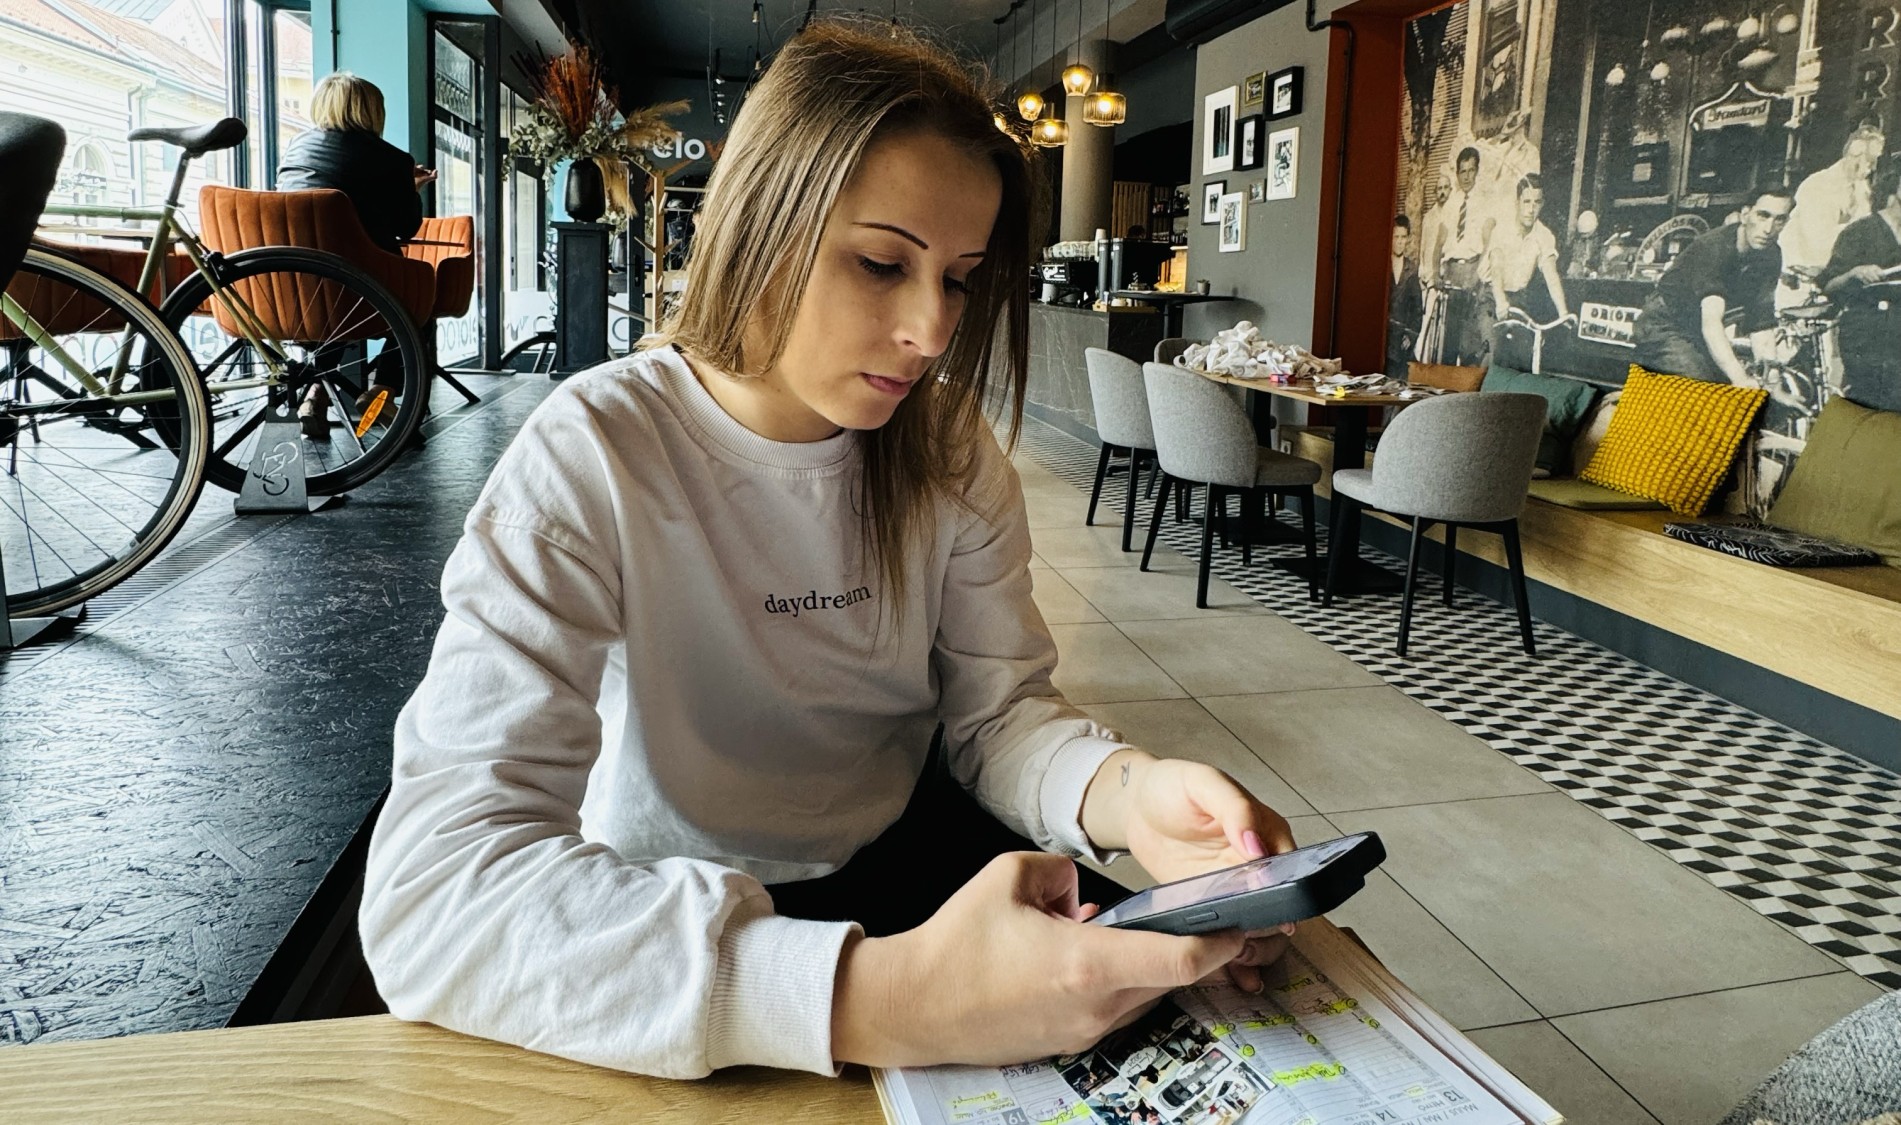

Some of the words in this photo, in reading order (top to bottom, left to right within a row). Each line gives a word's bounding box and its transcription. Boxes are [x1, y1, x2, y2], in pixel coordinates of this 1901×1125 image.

[764, 586, 872, 617] daydream
[1443, 1090, 1464, 1102] 13
[1007, 1113, 1026, 1125] 19
[1375, 1109, 1397, 1121] 14
